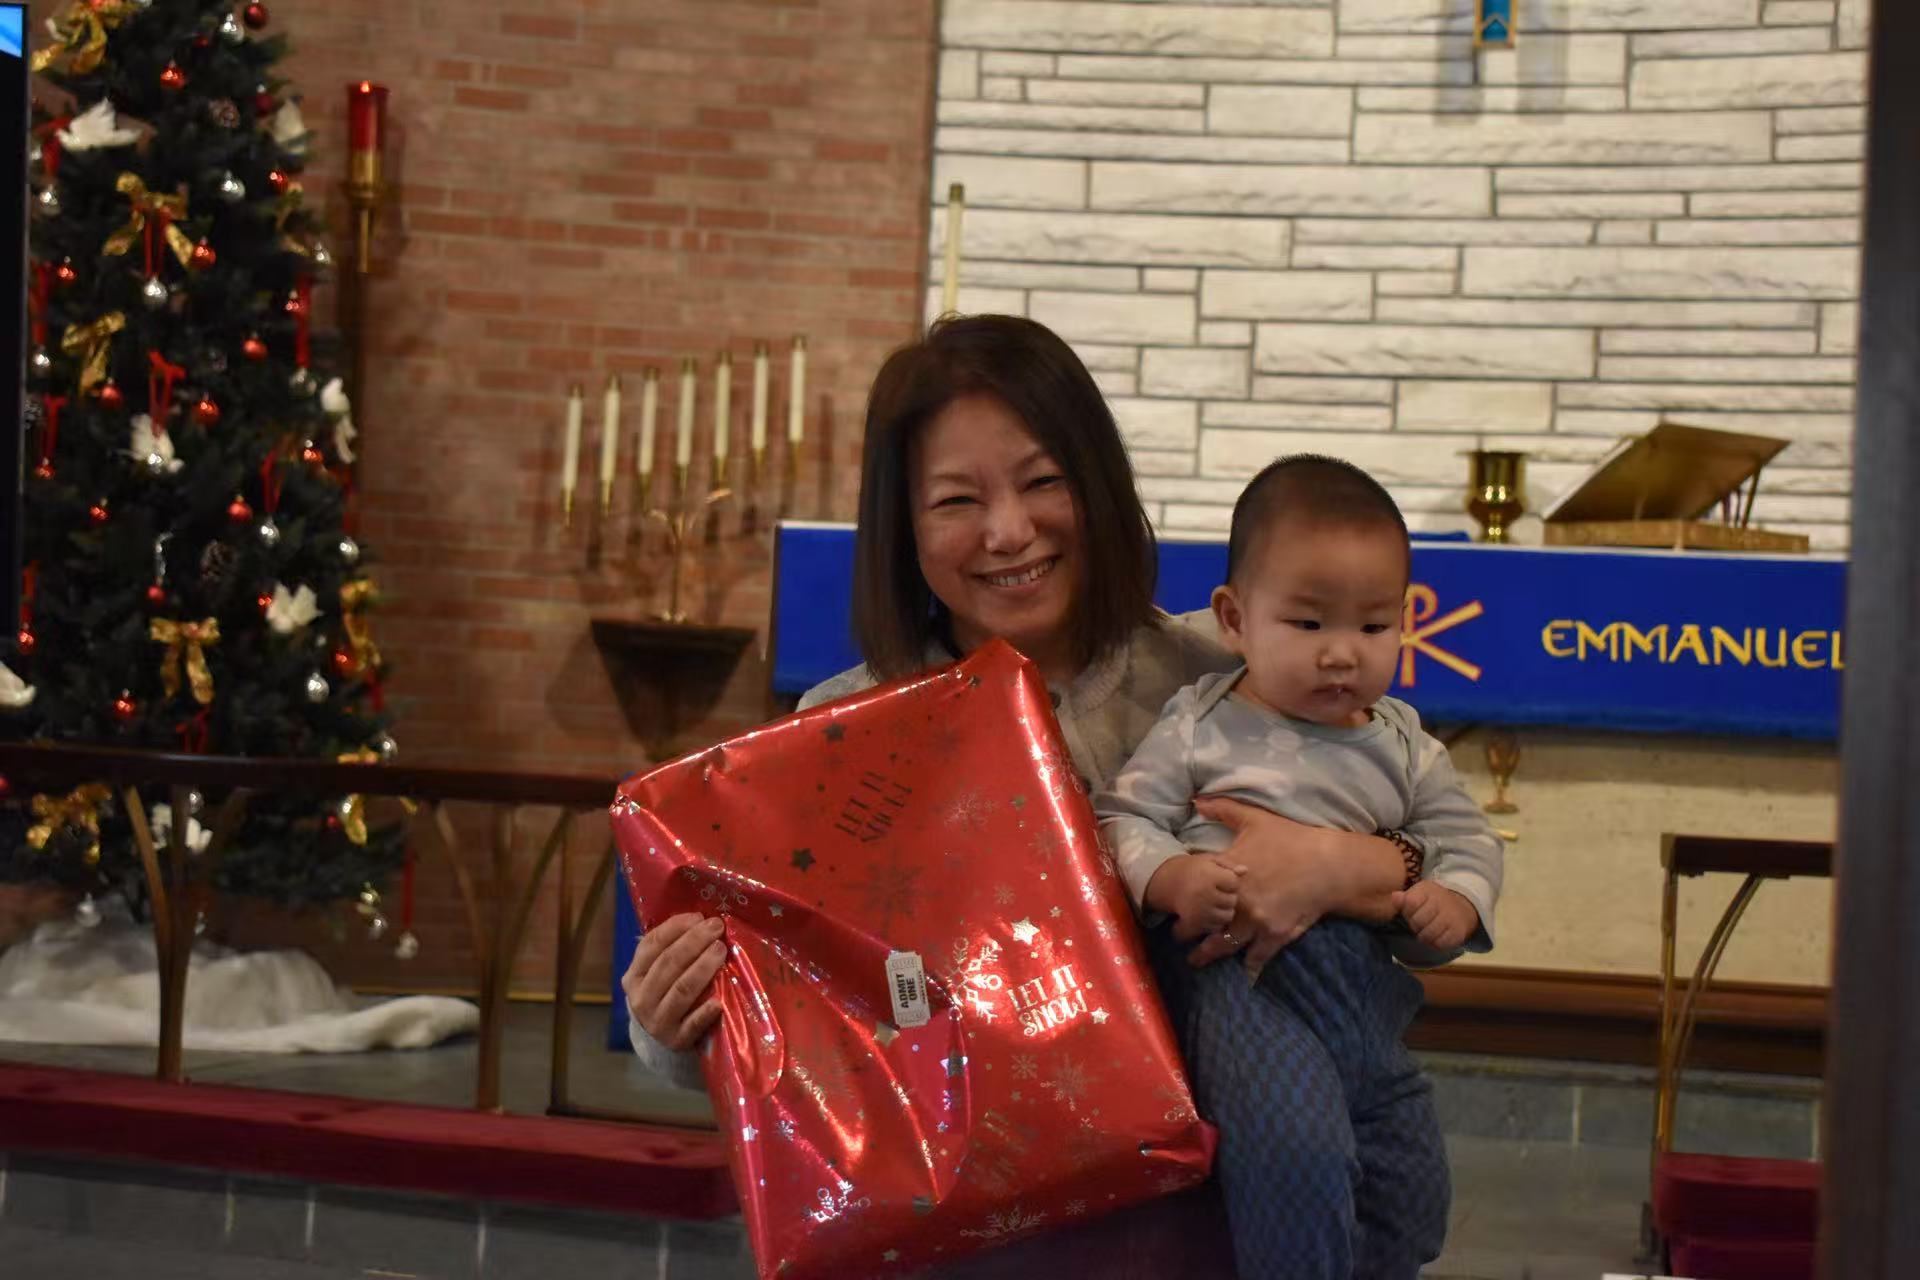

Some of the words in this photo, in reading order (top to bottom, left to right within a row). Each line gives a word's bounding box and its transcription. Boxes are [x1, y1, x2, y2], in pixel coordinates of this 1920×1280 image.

[1541, 619, 1845, 670] EMMANUEL
[896, 973, 909, 1009] ADMIT
[906, 977, 918, 1001] ONE
[1006, 976, 1048, 1012] LET
[1051, 963, 1077, 995] IT
[1018, 988, 1088, 1037] SNOW
